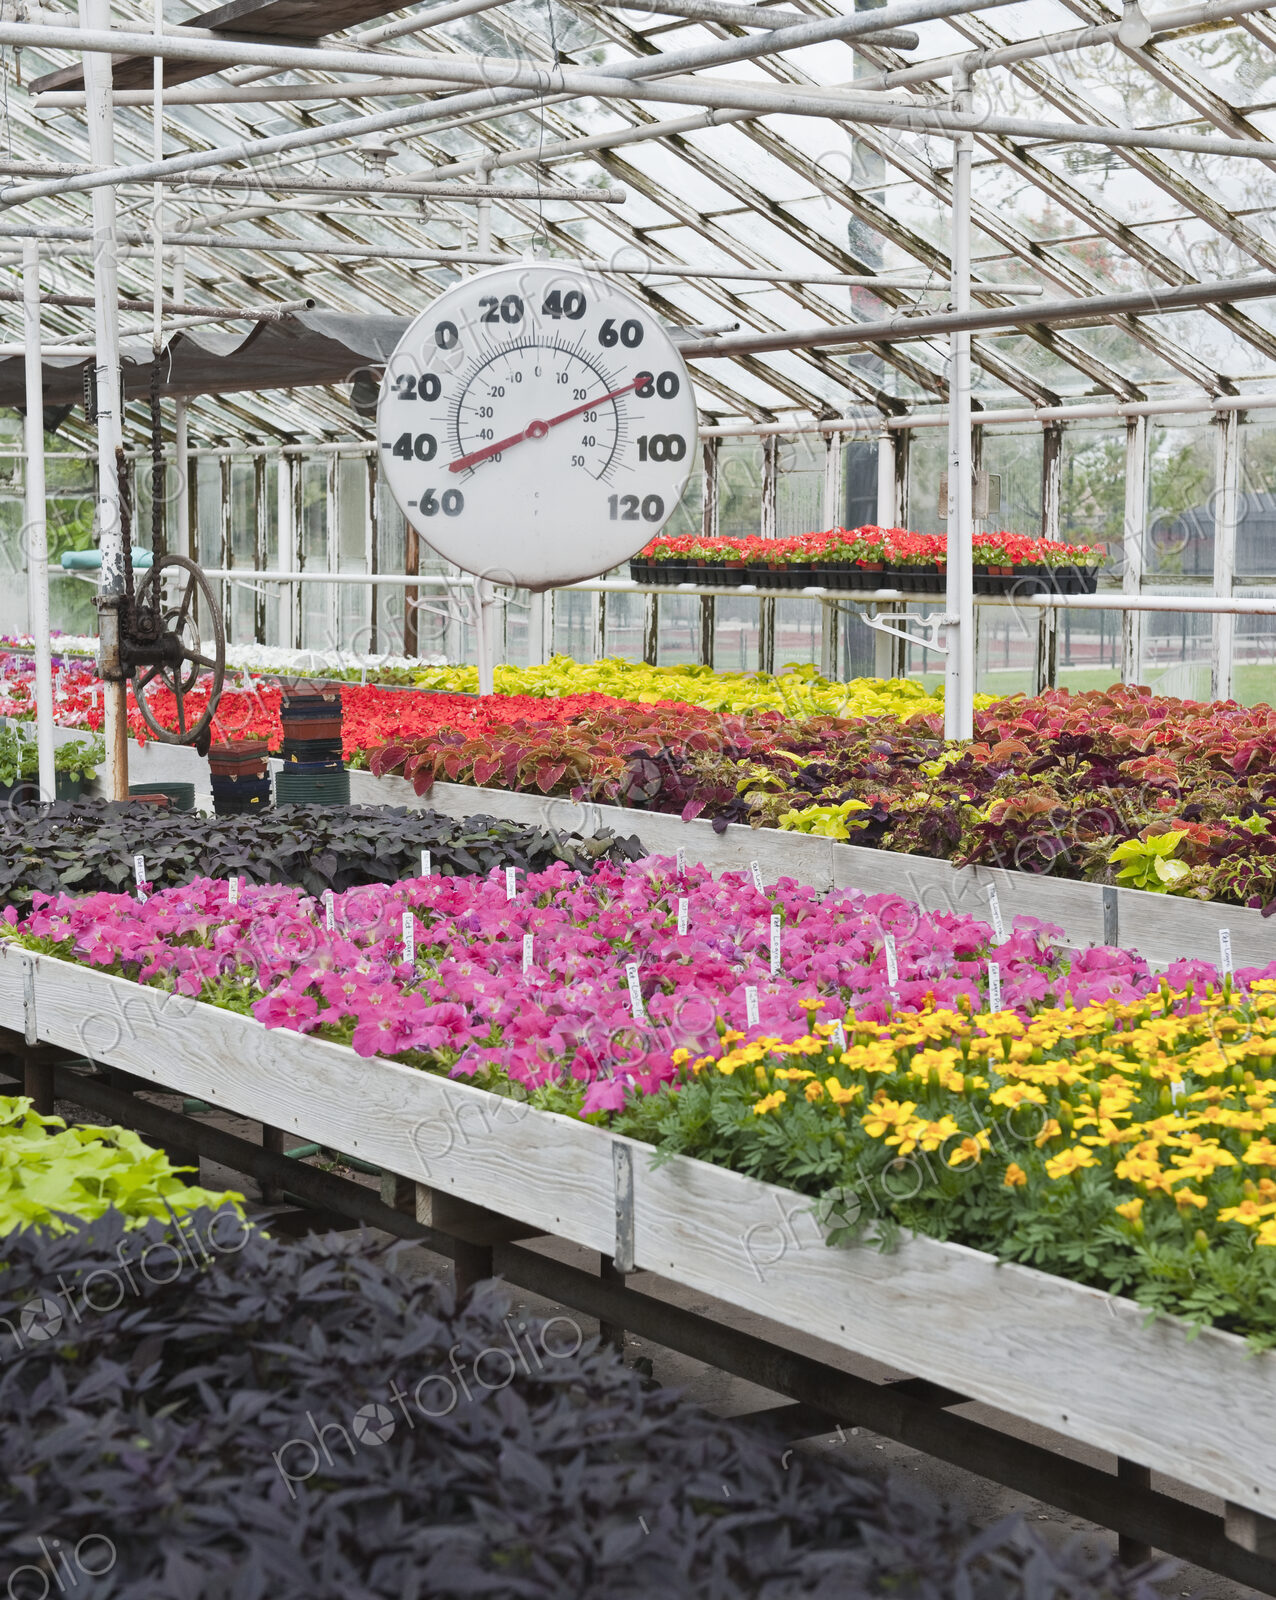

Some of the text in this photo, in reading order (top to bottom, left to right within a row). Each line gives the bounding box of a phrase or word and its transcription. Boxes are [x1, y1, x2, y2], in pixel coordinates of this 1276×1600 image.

[478, 294, 524, 324] 20
[541, 290, 587, 320] 40
[434, 320, 459, 350] 0
[598, 318, 644, 348] 60
[504, 372, 523, 384] -10
[534, 366, 542, 378] 0
[556, 373, 569, 384] 10
[391, 372, 442, 402] -20
[486, 387, 506, 398] -20
[572, 389, 587, 401] 20
[634, 370, 680, 400] 80
[474, 407, 494, 418] -30
[583, 411, 598, 423] 30
[475, 429, 494, 440] -40
[581, 436, 596, 448] 40
[381, 432, 437, 461] -40
[637, 433, 687, 462] 100
[571, 455, 585, 468] 50
[407, 488, 465, 517] -60
[607, 493, 665, 522] 120
